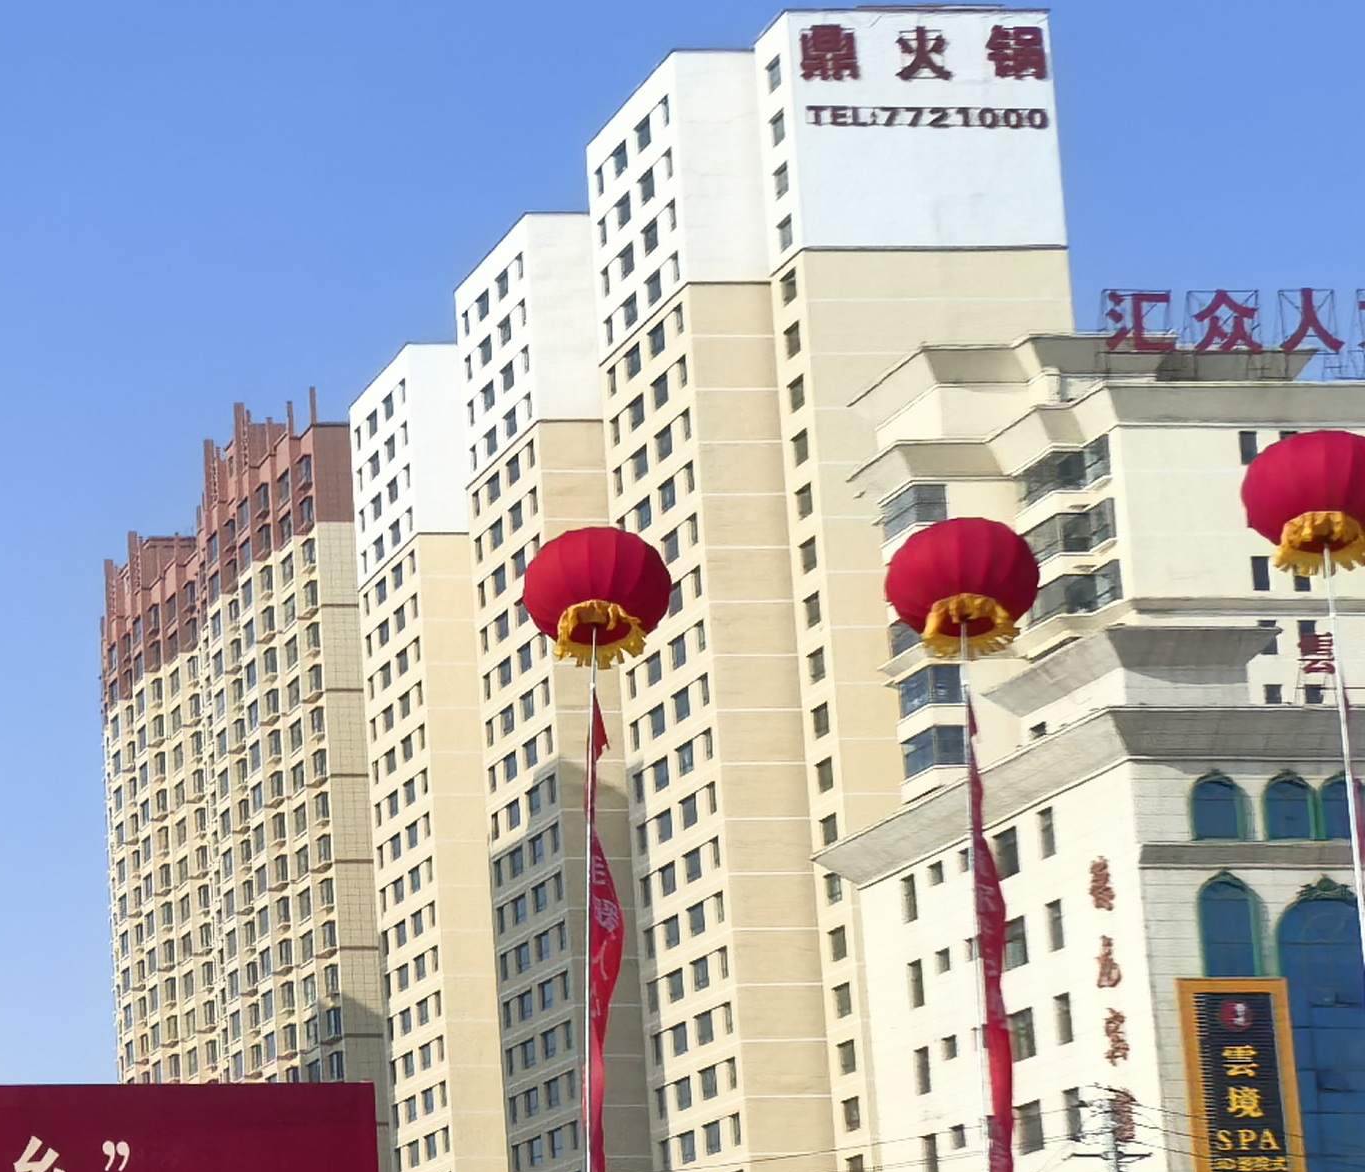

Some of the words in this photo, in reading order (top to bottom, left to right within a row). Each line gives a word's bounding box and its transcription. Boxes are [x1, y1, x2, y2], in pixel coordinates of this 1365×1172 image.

[1105, 287, 1365, 354] 汇众人
[1216, 1128, 1281, 1150] SPA
